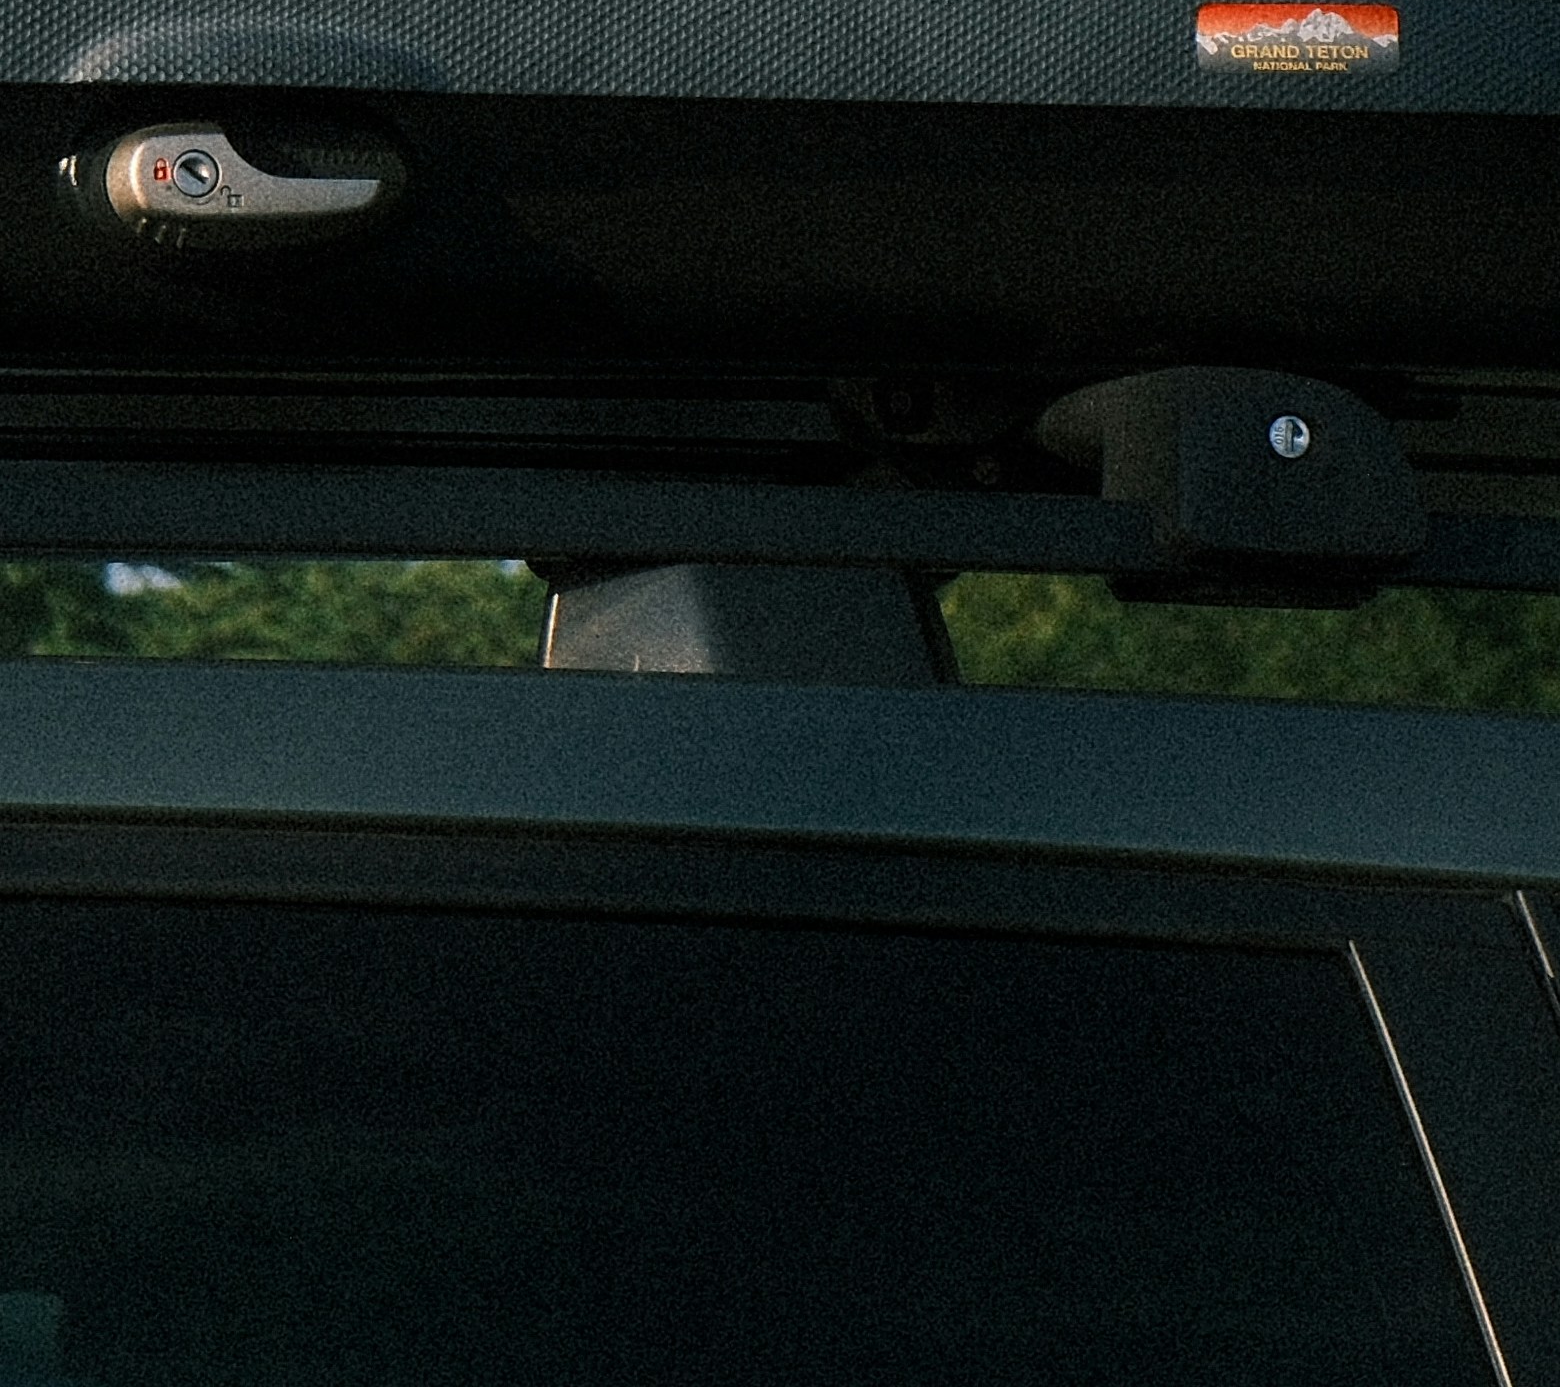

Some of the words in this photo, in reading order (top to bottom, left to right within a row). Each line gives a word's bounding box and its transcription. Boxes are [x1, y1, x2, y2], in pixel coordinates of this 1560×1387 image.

[1230, 45, 1300, 59] GRAND
[1306, 45, 1369, 59] TETON
[1253, 62, 1312, 71] NATIONAL
[1315, 62, 1348, 71] PARK
